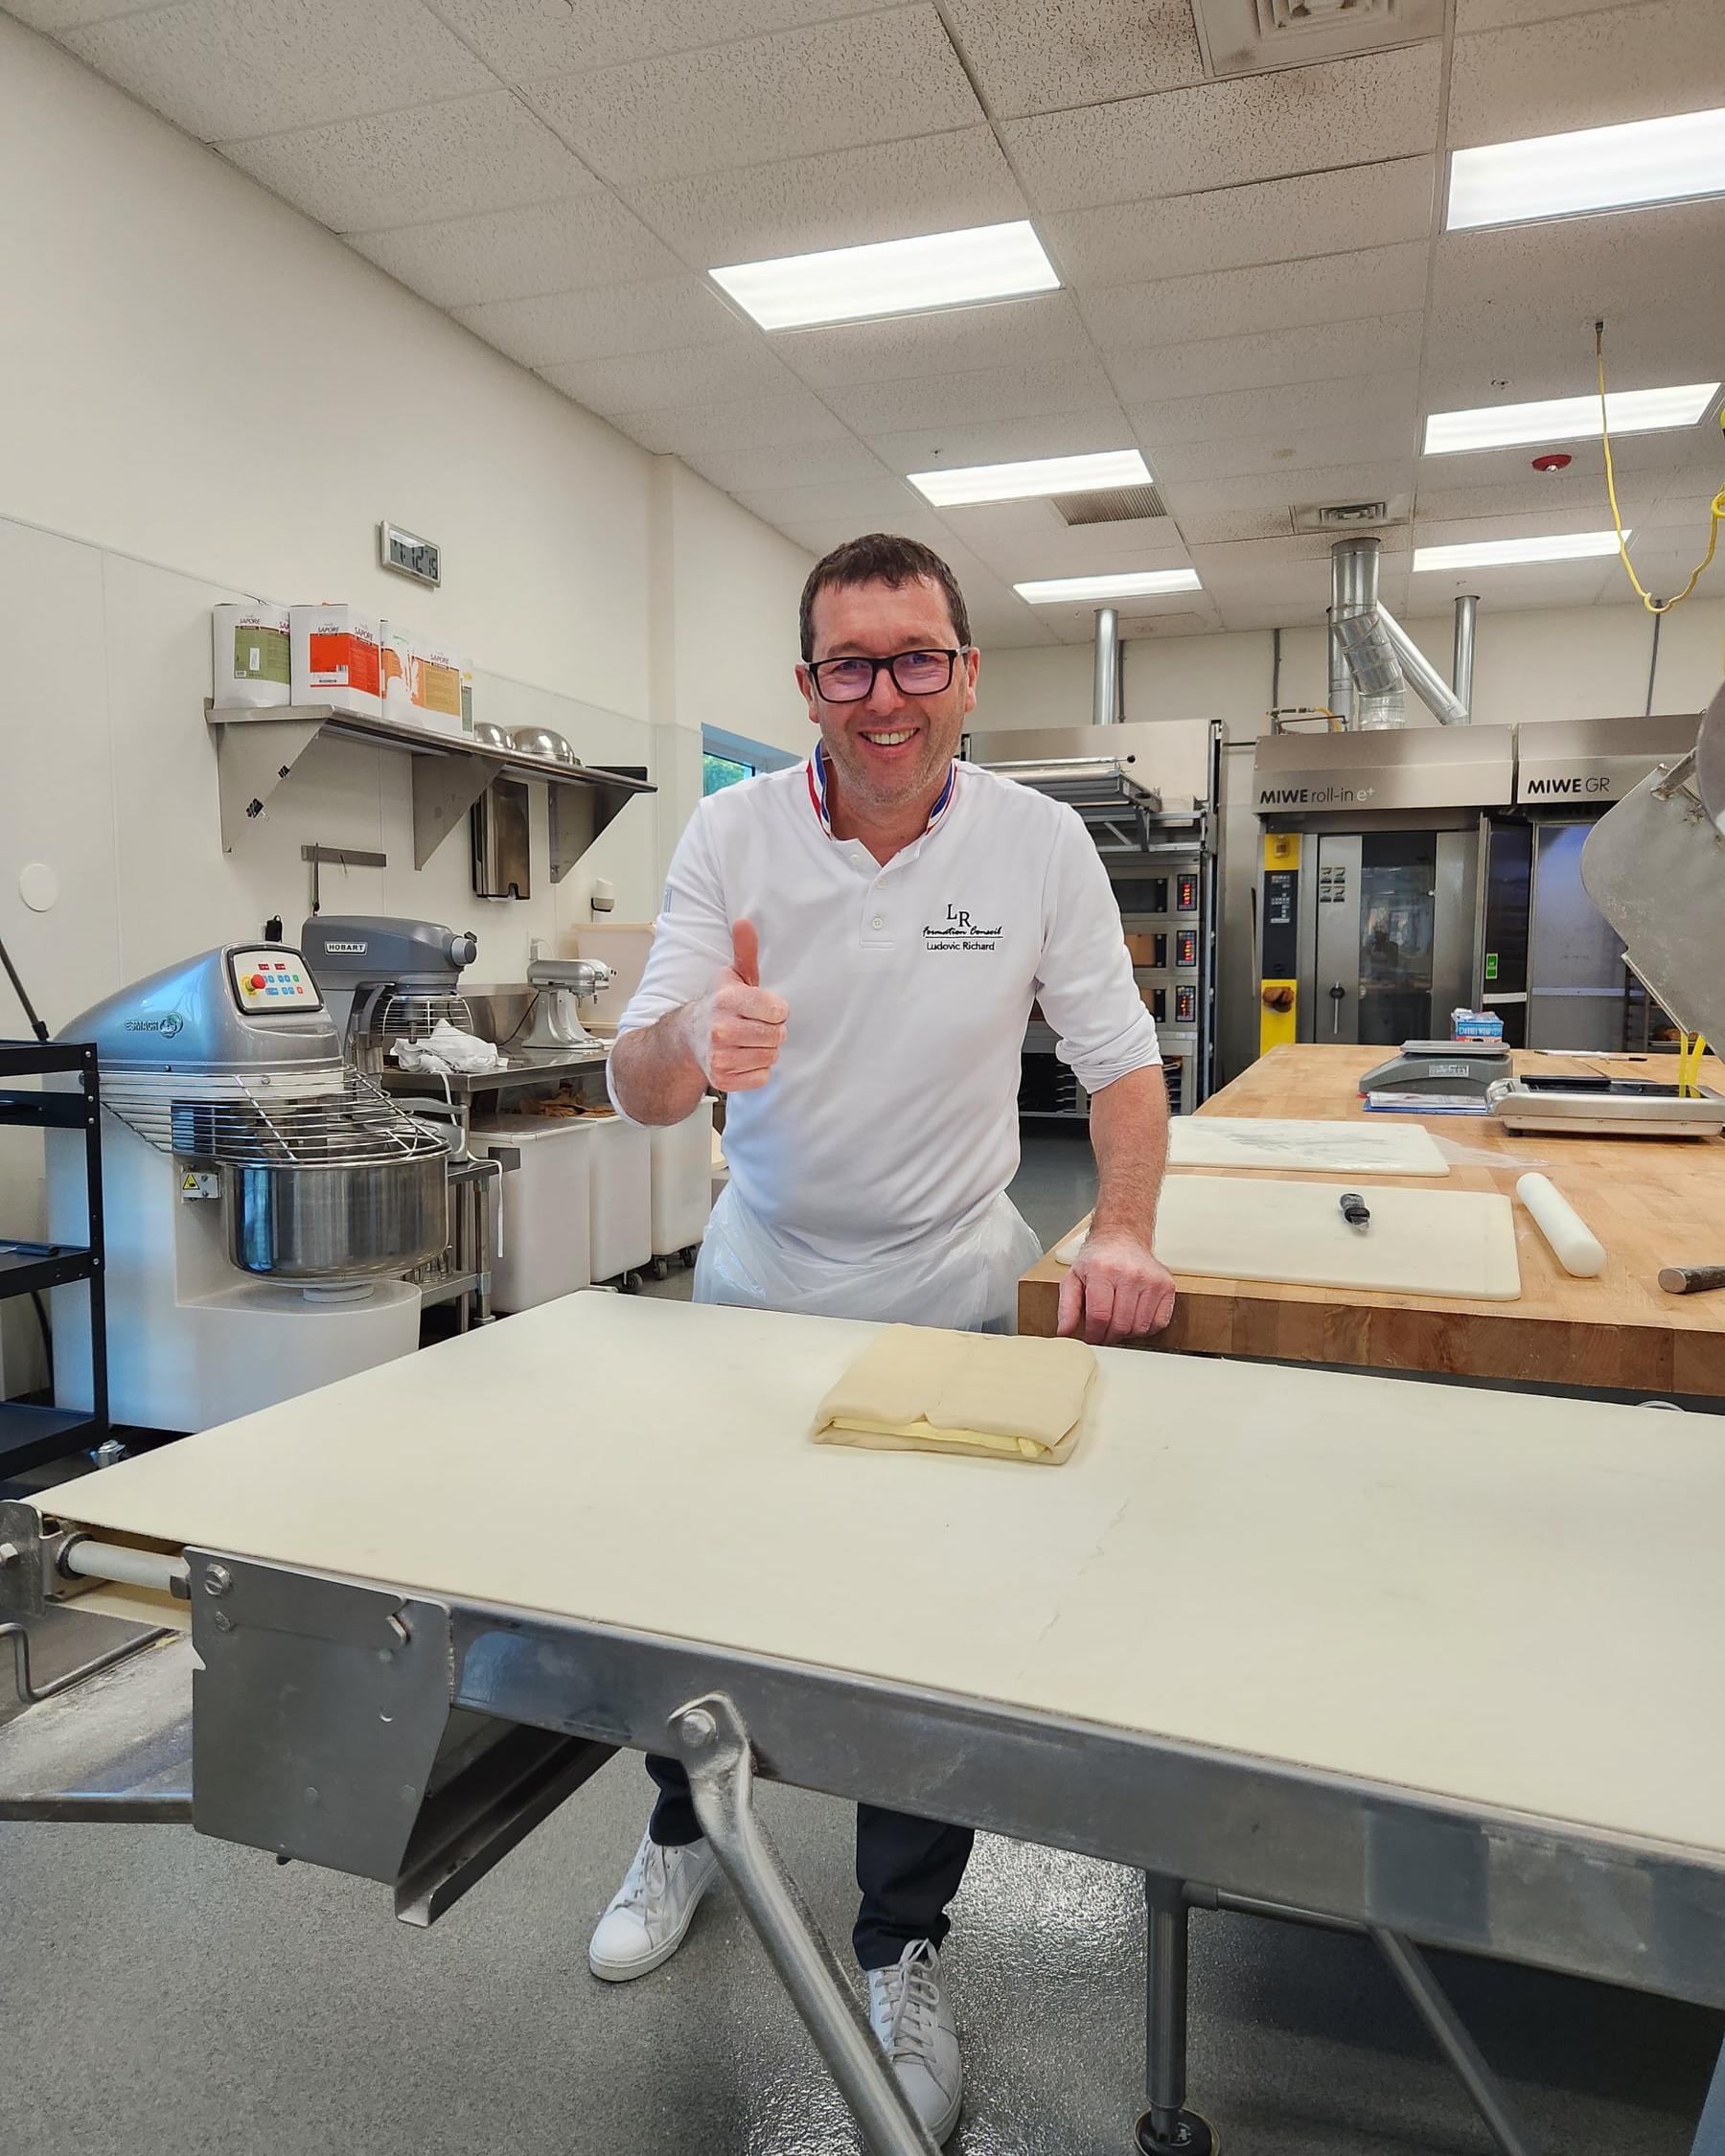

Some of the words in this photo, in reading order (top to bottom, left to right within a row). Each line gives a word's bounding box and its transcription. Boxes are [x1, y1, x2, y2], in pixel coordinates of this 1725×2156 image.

[1528, 778, 1582, 794] MIWE
[1585, 777, 1610, 793] GR
[1260, 789, 1309, 804] MIWE
[970, 925, 1002, 935] Conseil
[927, 941, 961, 951] Ludovic
[962, 941, 996, 951] Richard
